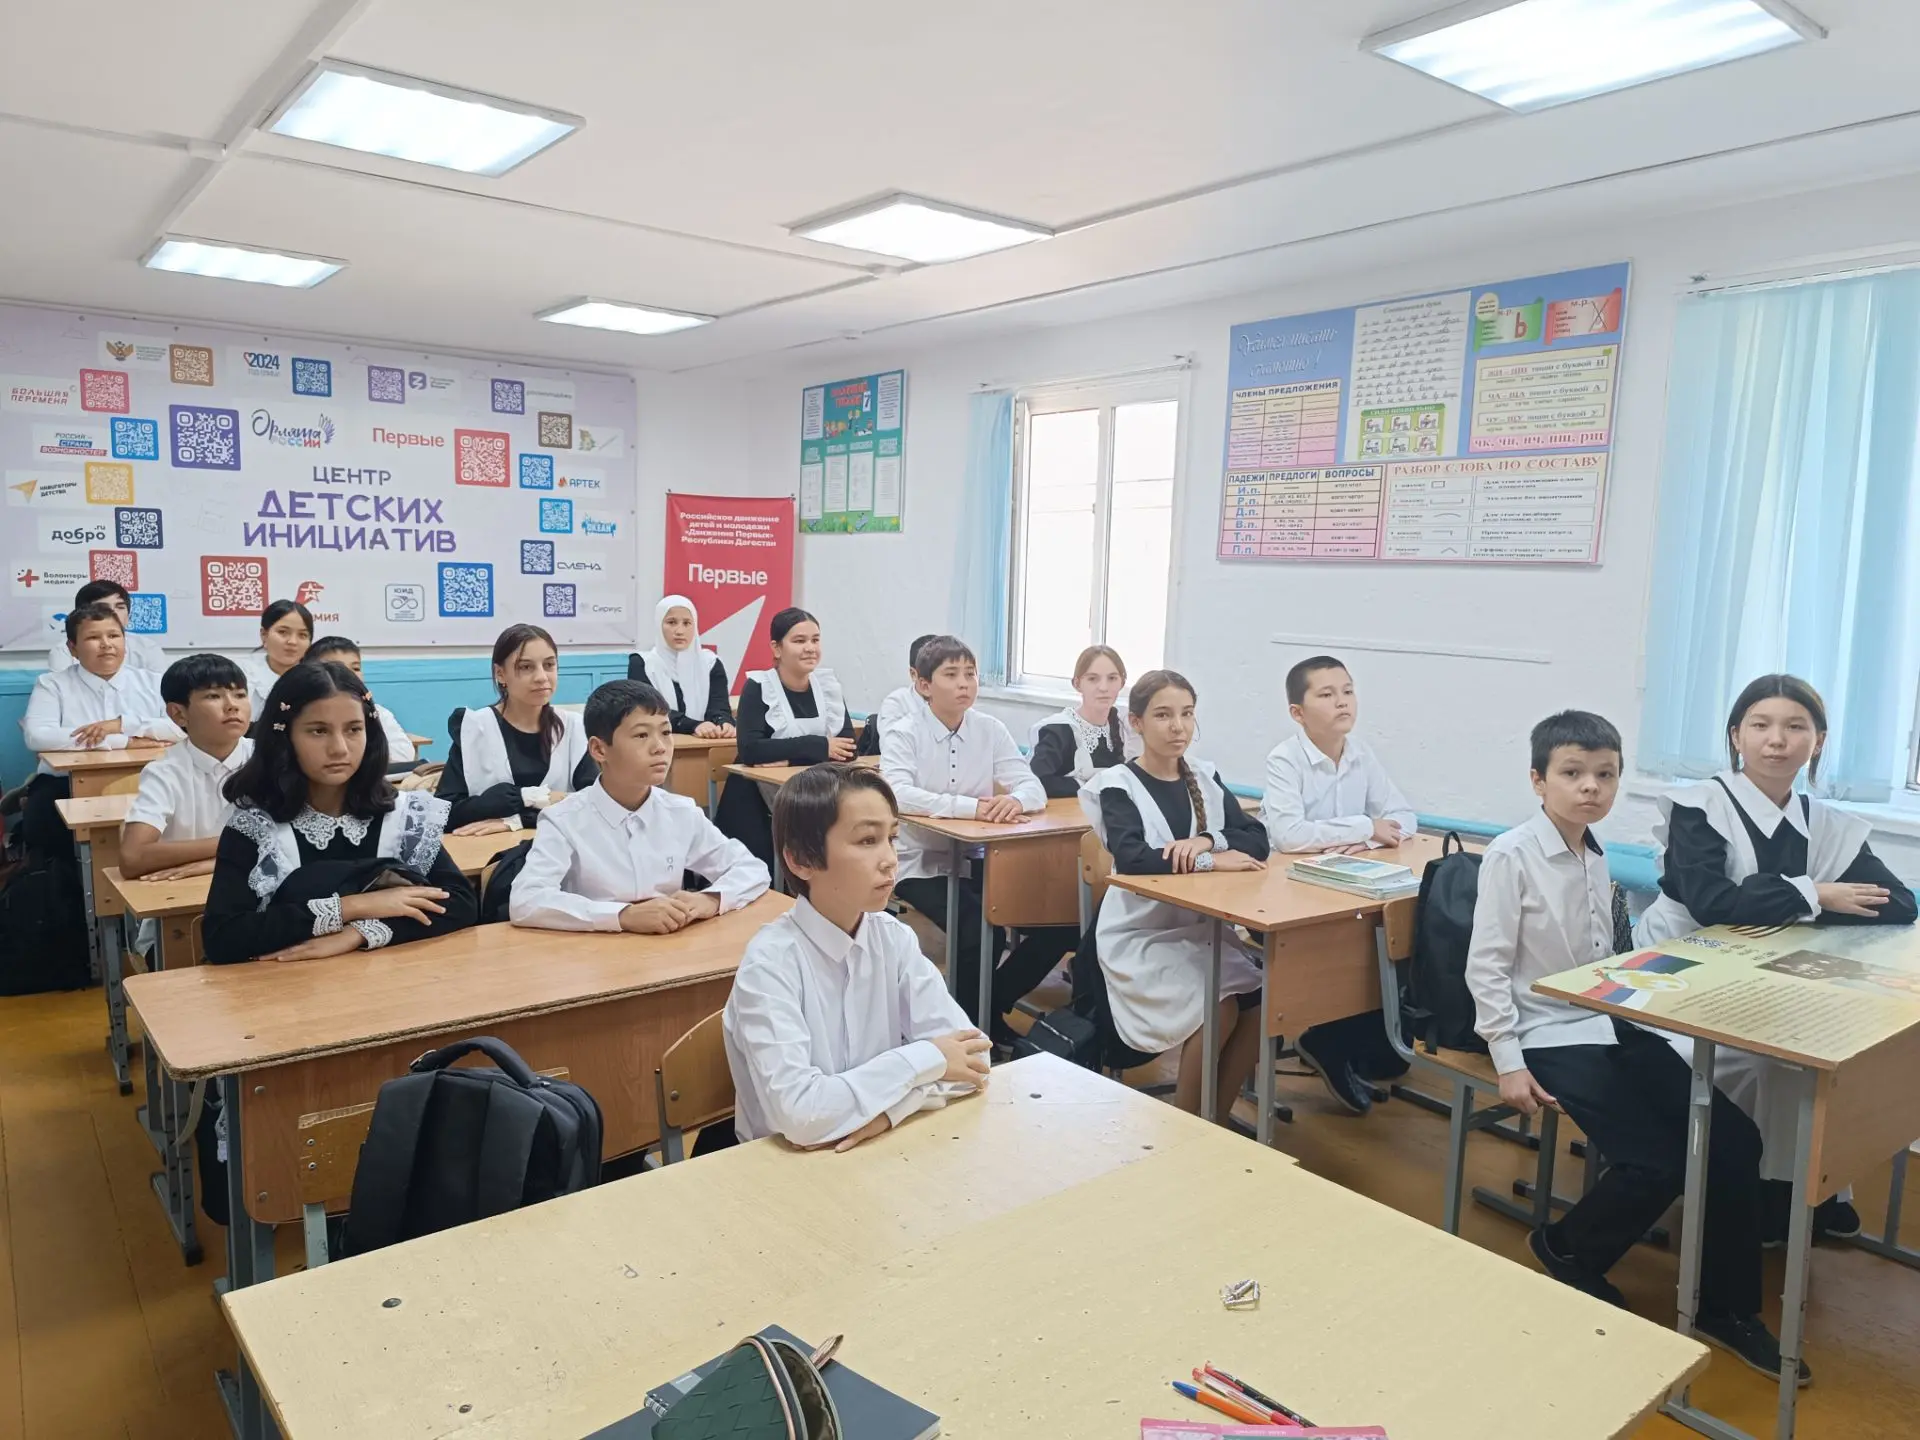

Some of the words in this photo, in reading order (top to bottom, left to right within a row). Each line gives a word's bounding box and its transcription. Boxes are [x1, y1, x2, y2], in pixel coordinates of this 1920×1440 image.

[250, 352, 280, 370] 2024
[1562, 361, 1591, 370] буквой
[11, 387, 69, 397] БОЛЬШАЯ
[1236, 389, 1266, 398] ЧЛЕНЫ
[1268, 381, 1338, 395] ПРЕДЛОЖЕНИЯ
[1559, 384, 1589, 394] буквой
[1557, 409, 1586, 419] буквой
[372, 427, 445, 449] Первые
[1394, 464, 1440, 475] РАЗБОР
[1446, 462, 1493, 473] СЛОВА
[1498, 460, 1521, 470] ПО
[1525, 455, 1602, 471] СОСТАВУ
[313, 466, 392, 486] ЦЕНТР
[1228, 474, 1265, 484] ПАДЕЖИ
[1268, 471, 1318, 481] ПРЕДЛОГИ
[1325, 468, 1374, 479] ВОПРОСЫ
[569, 478, 601, 489] АРТЕК
[1237, 486, 1261, 495] И.п.
[1237, 496, 1260, 505] Р.п.
[257, 489, 444, 524] ДЕТСКИХ
[680, 512, 733, 521] Российское
[1235, 507, 1259, 517] Д.п.
[1235, 520, 1258, 529] В.п.
[52, 528, 106, 543] добро
[243, 522, 457, 553] ИНИЦИАТИВ
[735, 530, 774, 539] Первых»
[1233, 532, 1256, 541] Т.п.
[681, 536, 734, 545] Республики
[735, 538, 777, 547] Дагестан
[1232, 545, 1255, 555] П.п.
[688, 563, 768, 589] Первые
